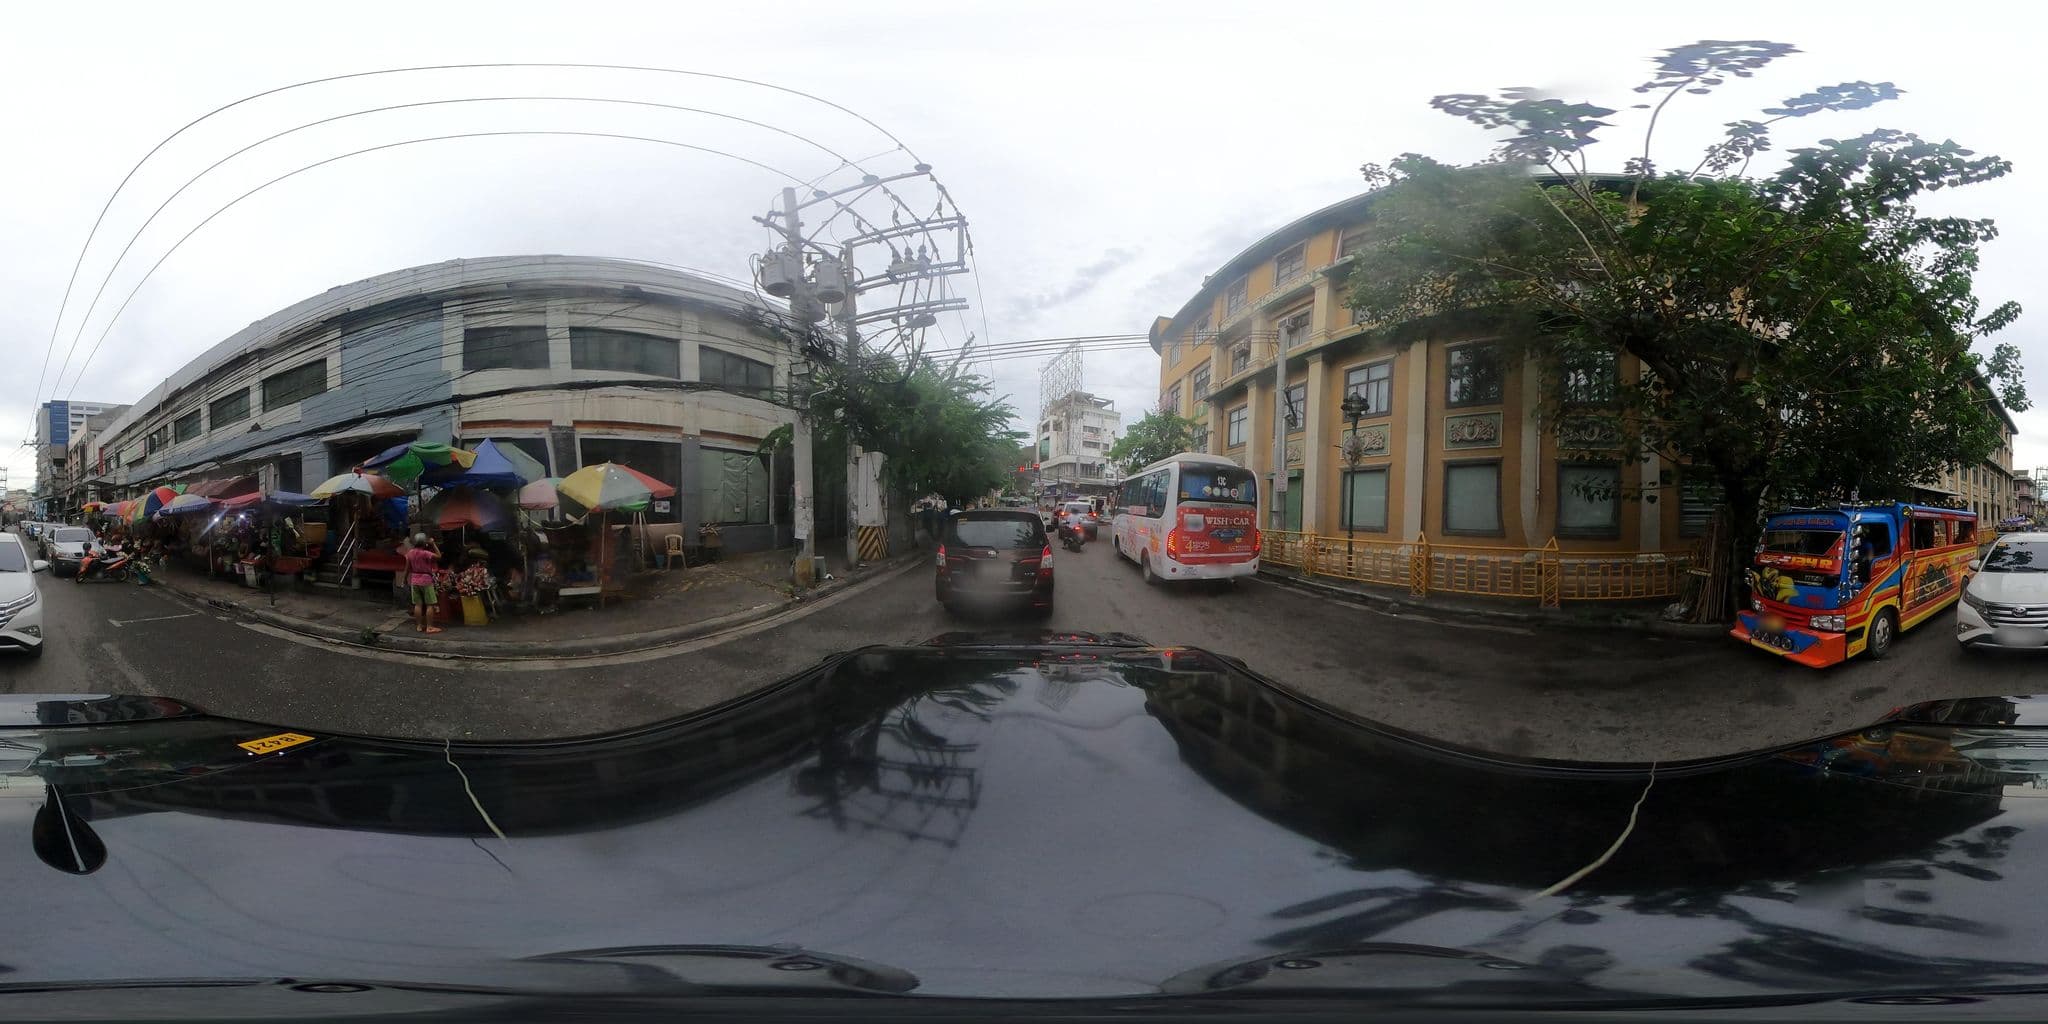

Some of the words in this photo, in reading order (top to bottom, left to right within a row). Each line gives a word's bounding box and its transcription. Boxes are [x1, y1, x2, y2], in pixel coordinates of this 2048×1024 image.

[1217, 476, 1227, 486] 13C
[1205, 516, 1228, 525] WISH
[1233, 517, 1250, 526] CAR
